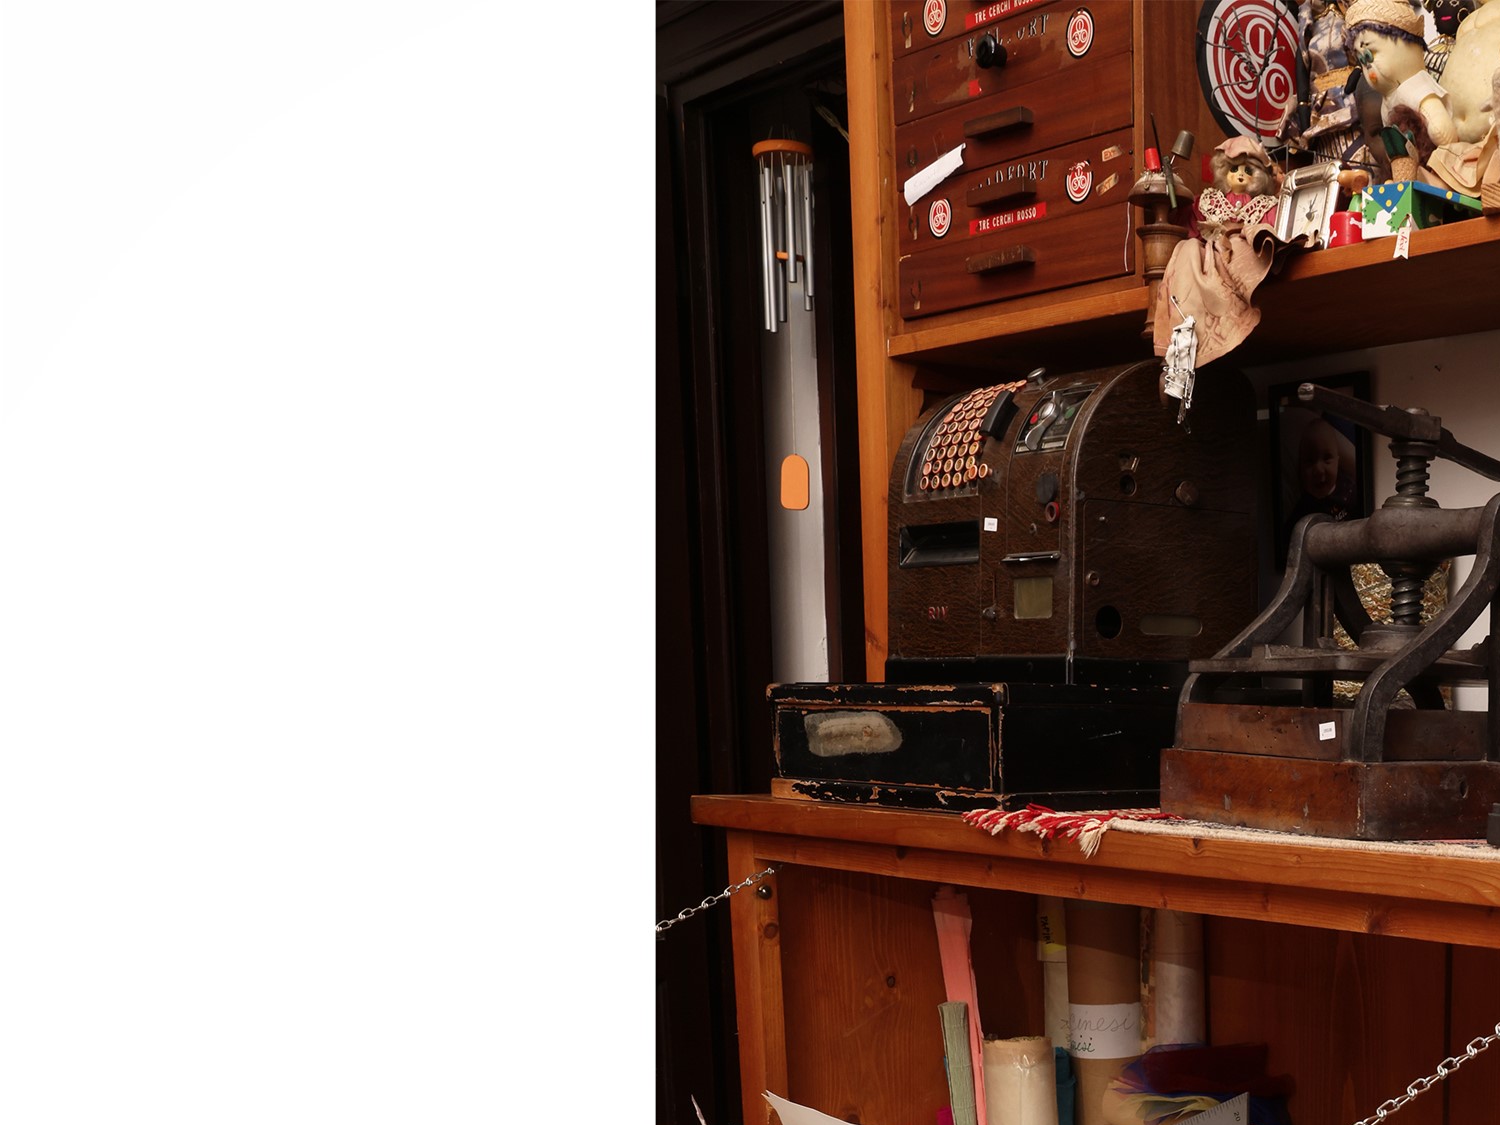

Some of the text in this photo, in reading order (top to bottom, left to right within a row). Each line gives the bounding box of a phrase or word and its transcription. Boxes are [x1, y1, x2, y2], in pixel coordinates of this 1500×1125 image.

[974, 9, 987, 24] TRE
[988, 0, 1011, 18] CERCHI
[978, 207, 1037, 231] TRE CERCHI ROSSO
[1233, 1110, 1241, 1122] 20
